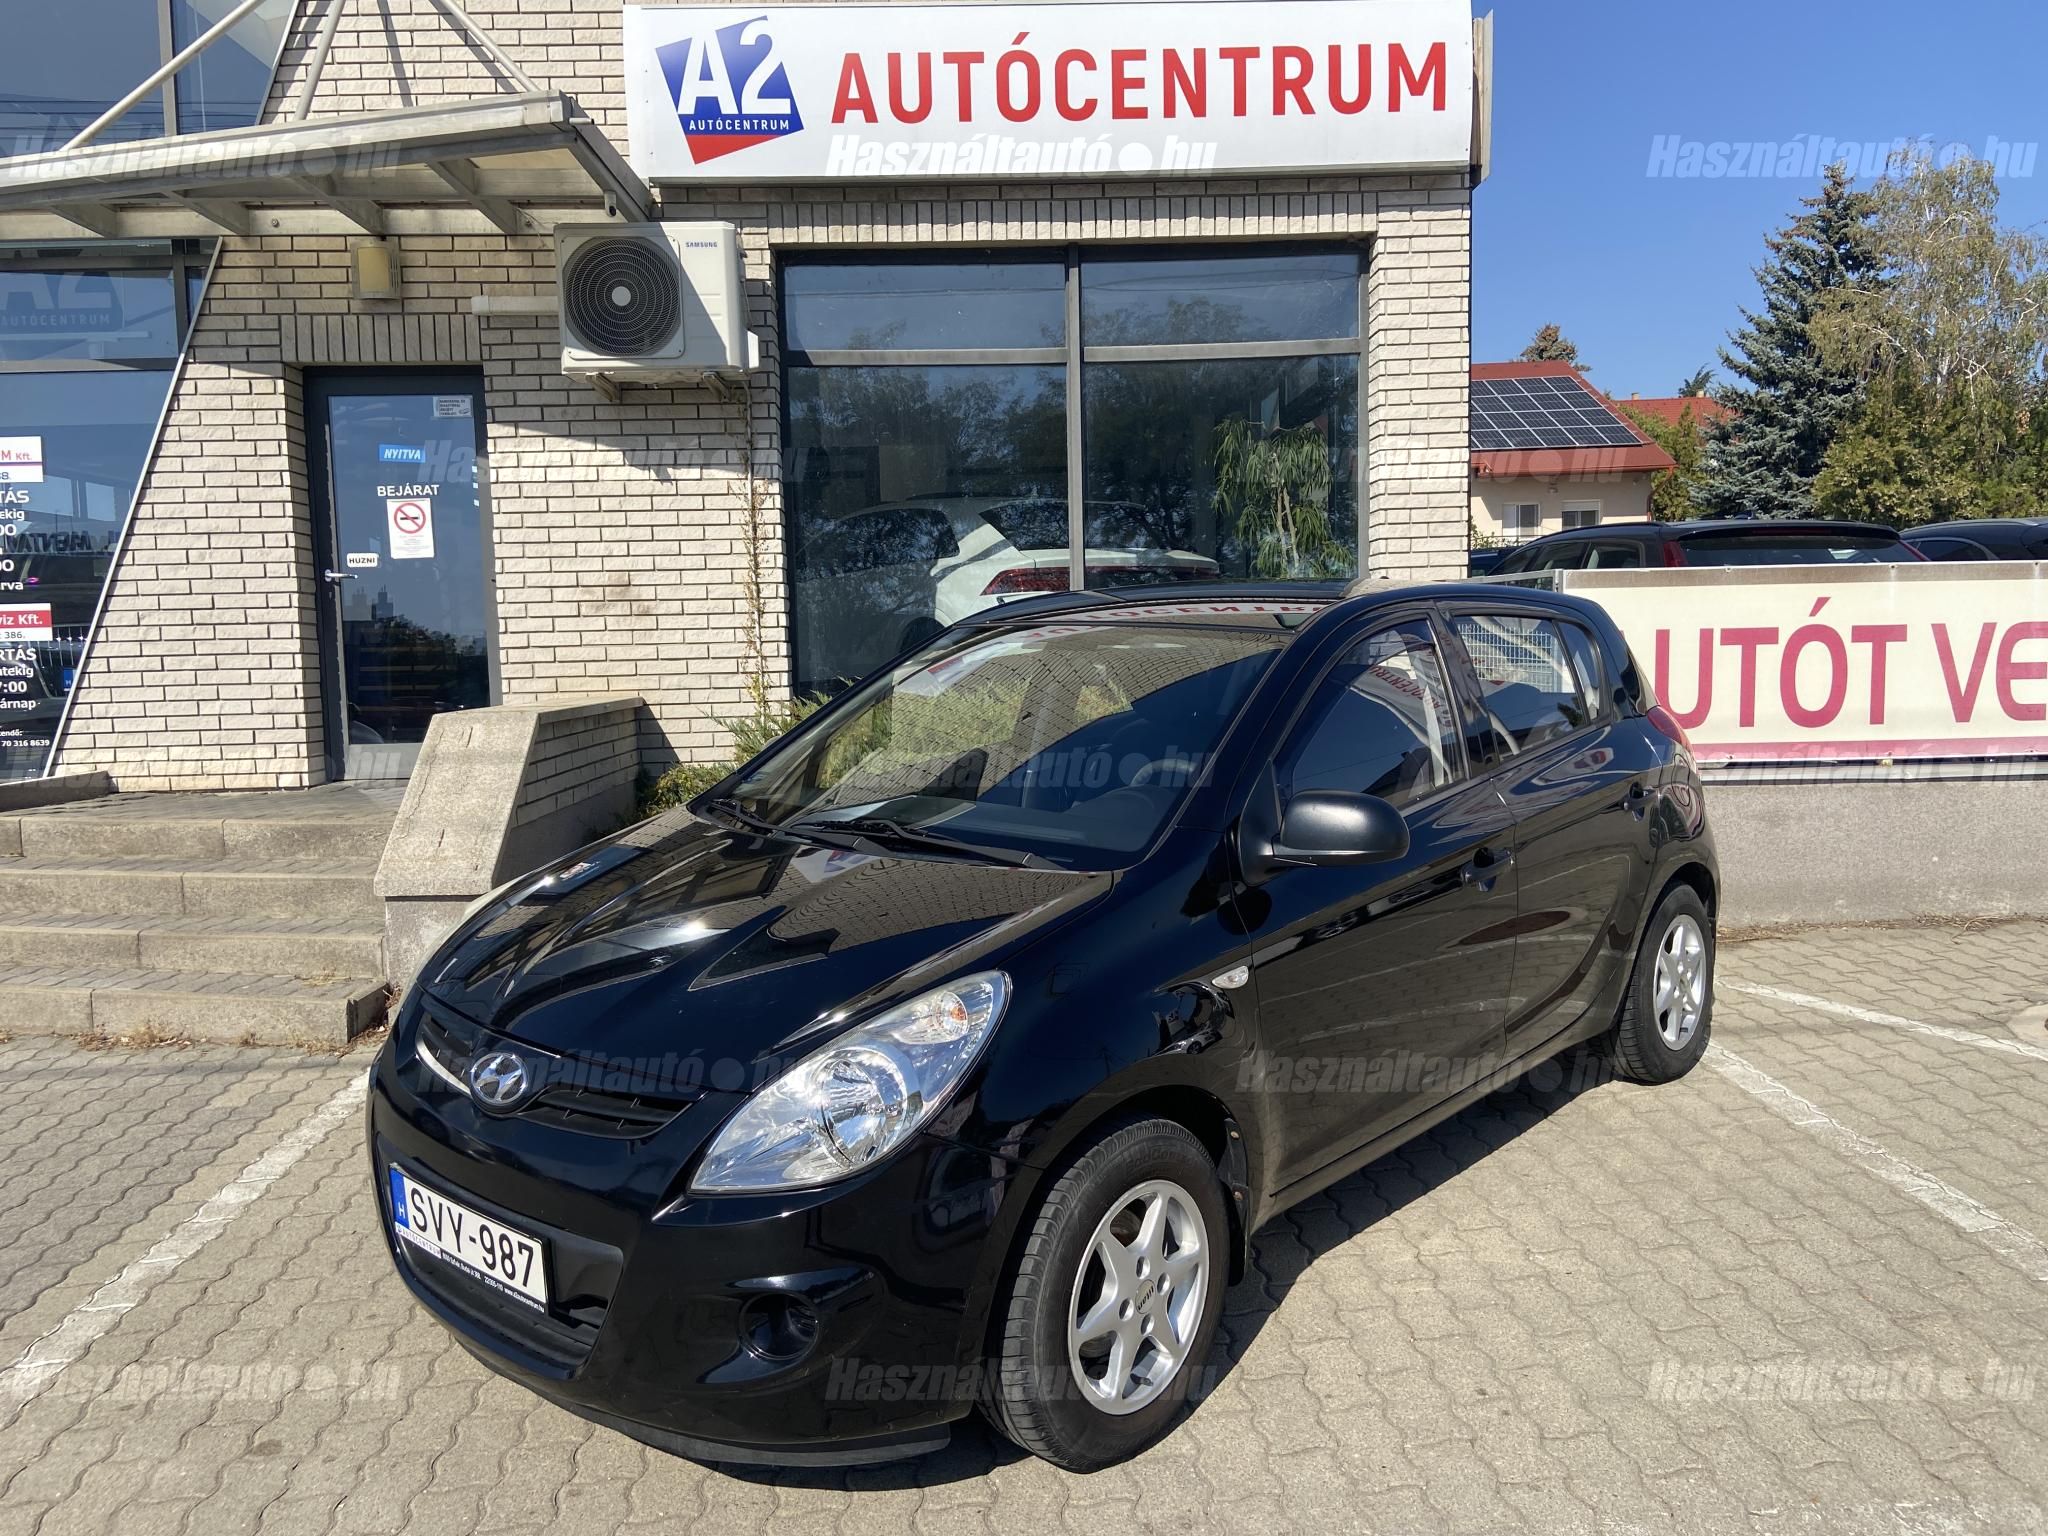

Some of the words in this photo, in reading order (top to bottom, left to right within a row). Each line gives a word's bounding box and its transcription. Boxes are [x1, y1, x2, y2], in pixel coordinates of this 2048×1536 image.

[677, 19, 791, 114] A2
[832, 32, 1446, 123] AUTÓCENTRUM
[689, 117, 789, 130] AUTÓCENTRUM
[16, 453, 32, 461] Kft.
[383, 448, 421, 460] NYITVA
[377, 482, 440, 497] BEJÁRAT
[18, 614, 43, 625] Kft.
[1622, 597, 1907, 729] UTÓT
[0, 681, 27, 693] :00
[2, 740, 12, 748] 70
[30, 739, 50, 747] 8639
[397, 1202, 406, 1219] H
[410, 1187, 535, 1288] SVY-987
